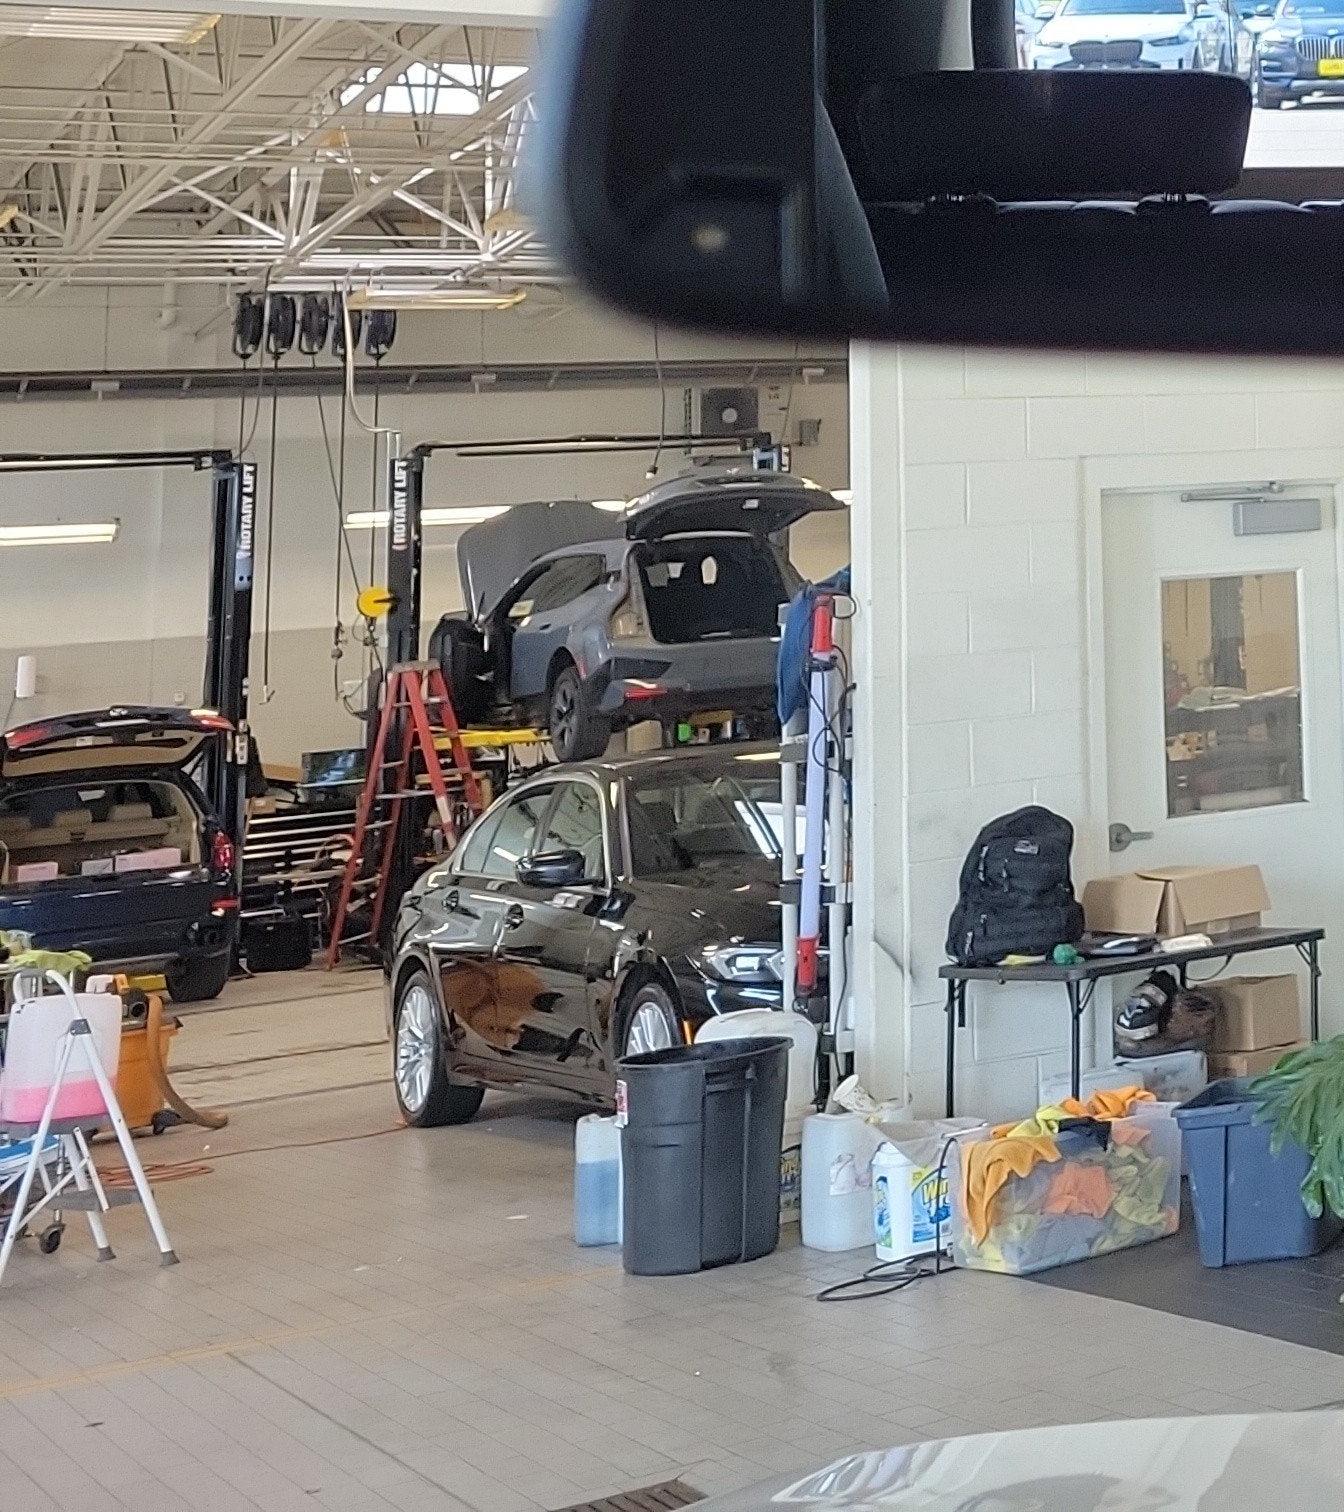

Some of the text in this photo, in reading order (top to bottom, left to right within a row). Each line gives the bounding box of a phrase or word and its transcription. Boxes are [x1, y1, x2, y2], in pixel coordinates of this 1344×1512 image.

[240, 463, 255, 550] ROTARY LIFT
[393, 460, 408, 544] ROTARY LIFT
